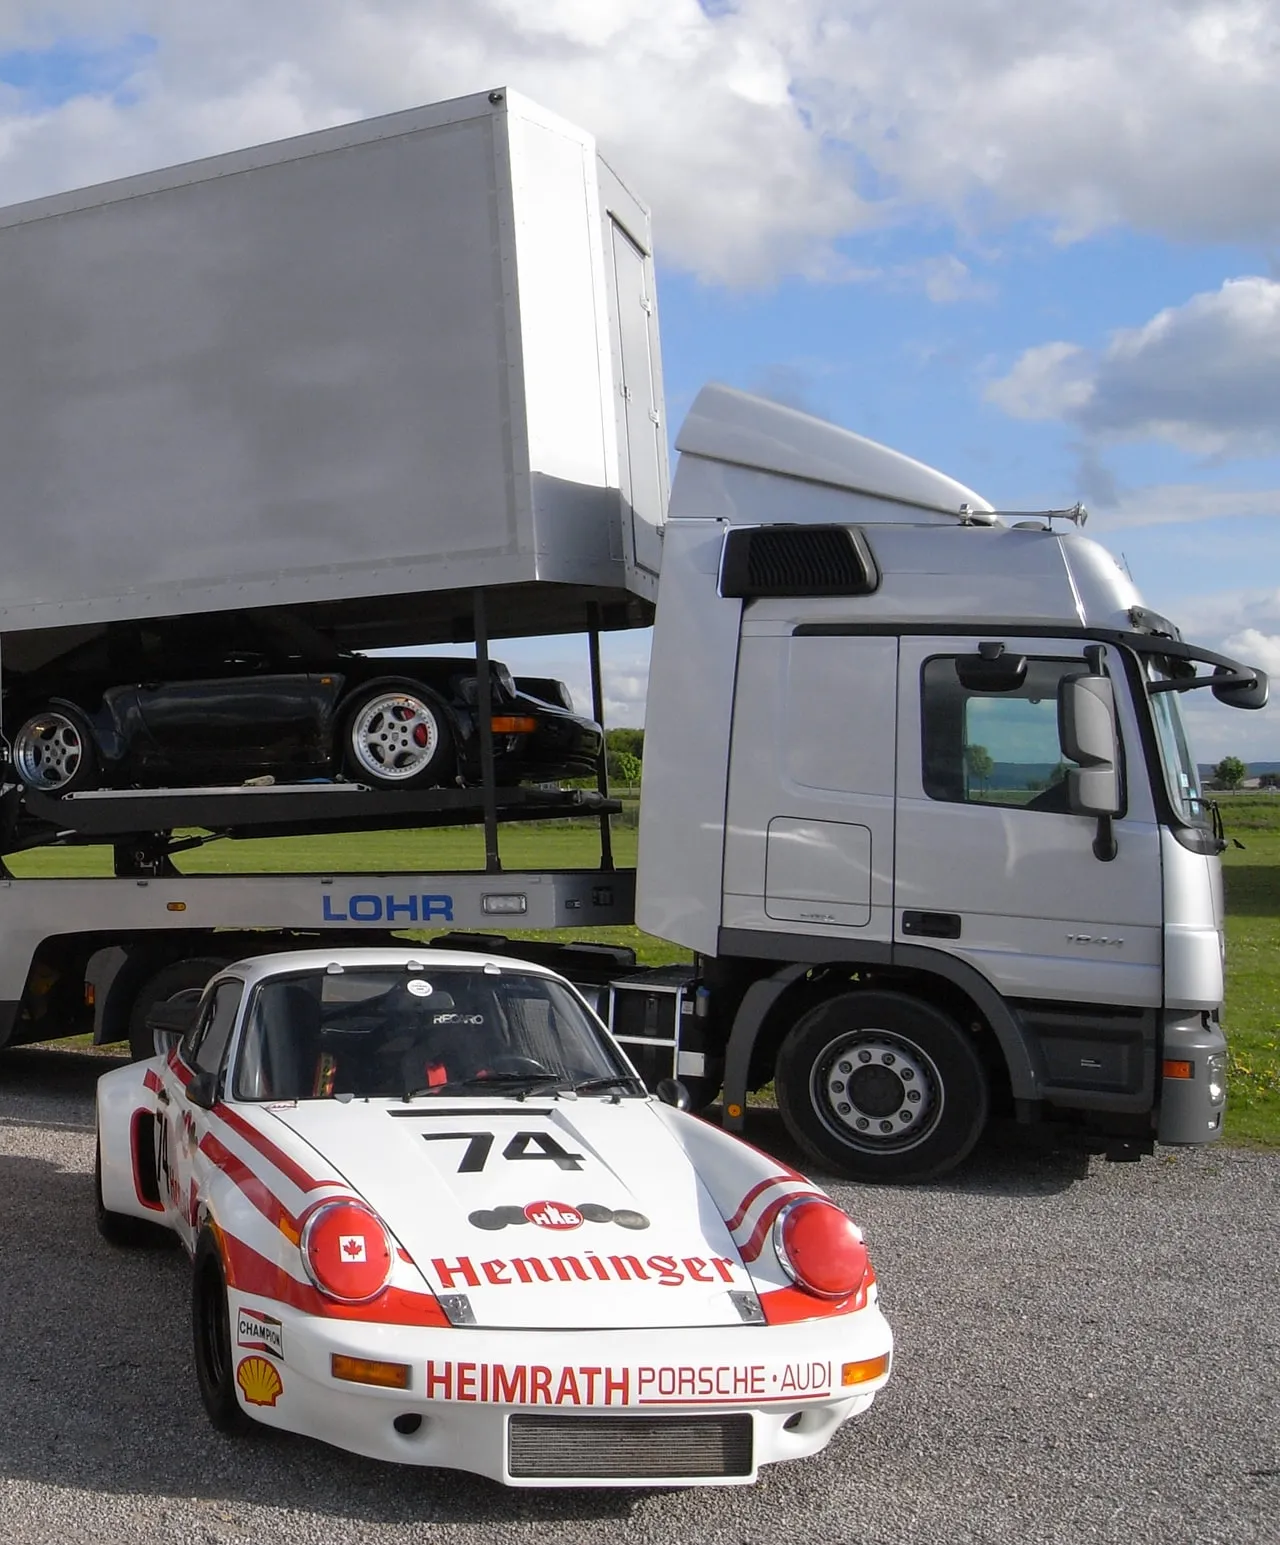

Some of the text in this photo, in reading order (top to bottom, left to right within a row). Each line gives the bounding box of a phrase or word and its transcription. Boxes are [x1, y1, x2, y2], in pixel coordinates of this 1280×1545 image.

[322, 894, 454, 922] LOHR
[433, 1013, 485, 1025] RECARO
[421, 1131, 587, 1174] 74
[431, 1250, 736, 1287] Henninger
[239, 1320, 281, 1347] CHAMPION
[426, 1360, 833, 1406] HEIMRATH PORSCHE AUDI
